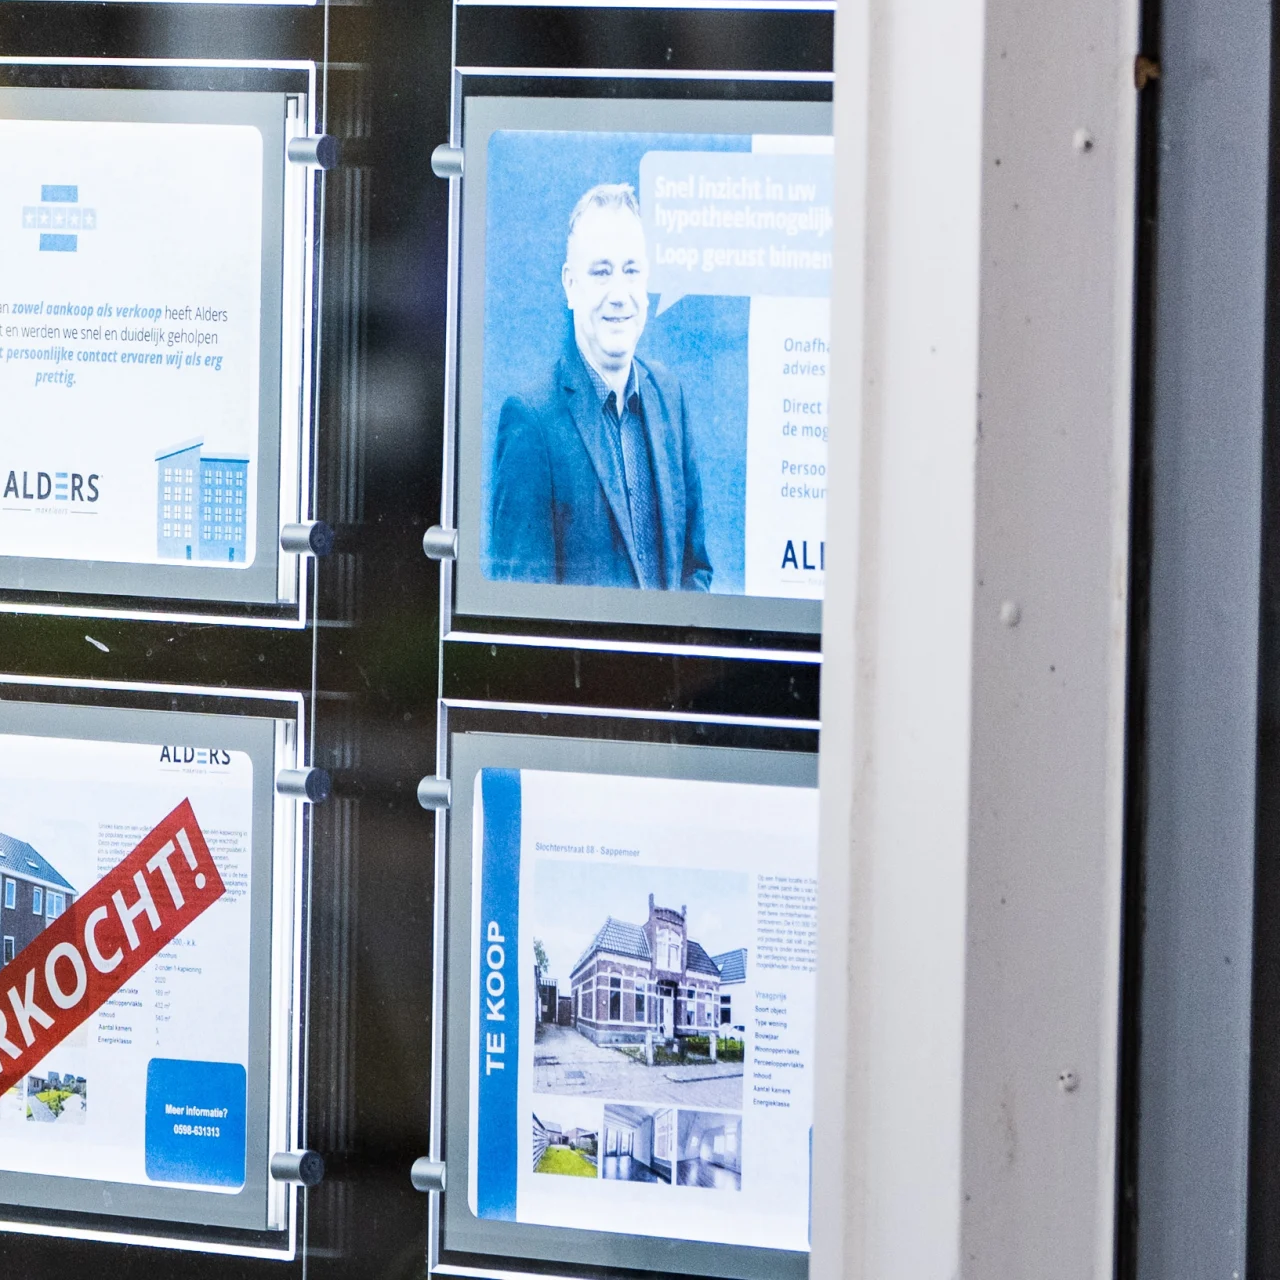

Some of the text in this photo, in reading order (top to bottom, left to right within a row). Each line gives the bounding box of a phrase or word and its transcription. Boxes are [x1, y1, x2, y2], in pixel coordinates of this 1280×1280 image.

[654, 175, 816, 201] Snel inzicht in uw
[656, 243, 698, 271] Loop
[702, 247, 766, 272] gerust
[12, 301, 44, 315] zowel
[46, 302, 94, 320] aankoop
[97, 303, 112, 317] als
[116, 304, 162, 322] verkoop
[165, 305, 192, 320] heeft
[195, 307, 228, 322] Alders
[6, 326, 18, 336] en
[21, 324, 60, 339] werden
[63, 328, 78, 339] we
[81, 326, 102, 340] snel
[105, 330, 117, 340] en
[121, 327, 165, 346] duidelijk
[168, 329, 218, 347] geholpen
[6, 347, 74, 364] persoonlijke
[77, 349, 118, 363] contact
[121, 353, 163, 364] ervaren
[166, 351, 183, 369] wij
[185, 352, 202, 366] als
[205, 354, 223, 370] erg
[783, 360, 826, 376] advies
[35, 370, 76, 388] prettig.
[783, 399, 822, 414] Direct
[783, 421, 797, 436] de
[3, 471, 99, 502] ALDERS
[160, 746, 231, 765] ALDERS
[536, 842, 584, 853] Slochterstraat
[600, 846, 640, 857] Sappemeer
[487, 921, 506, 1076] TE KOOP
[165, 1104, 228, 1118] Meer informatie?
